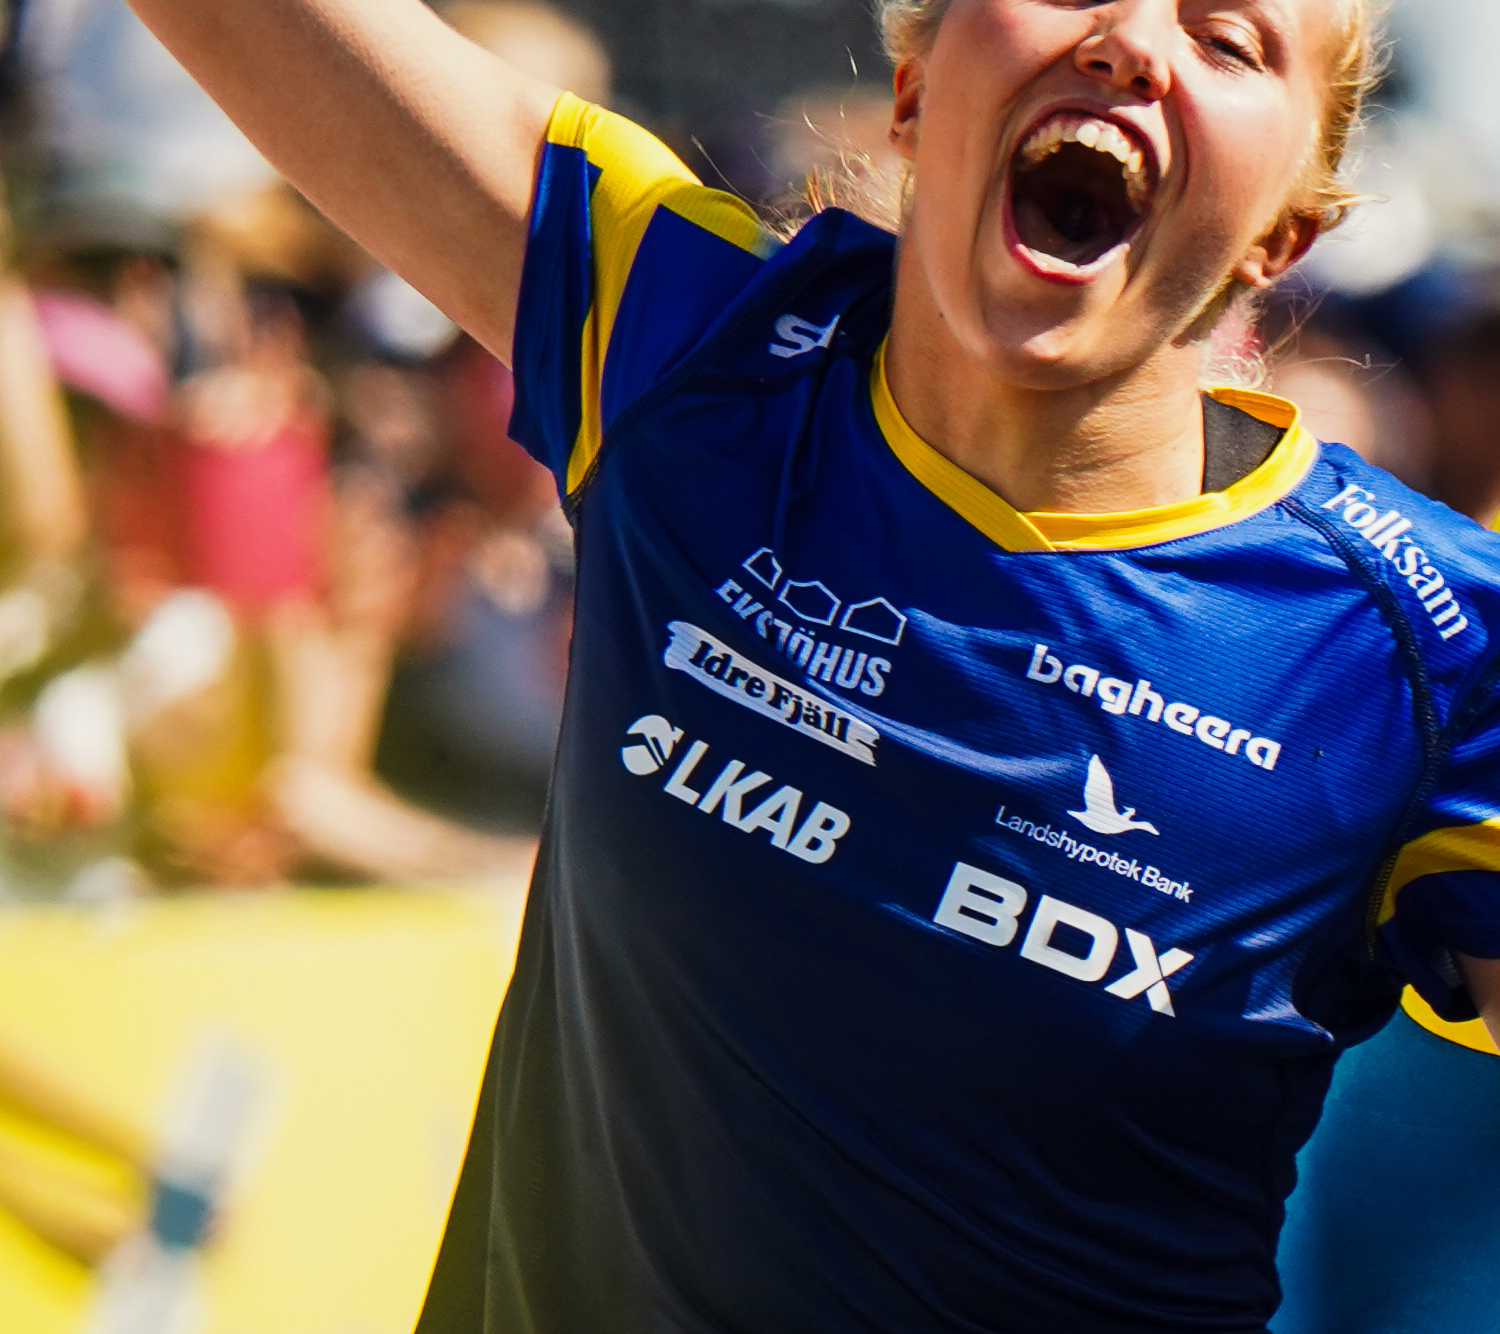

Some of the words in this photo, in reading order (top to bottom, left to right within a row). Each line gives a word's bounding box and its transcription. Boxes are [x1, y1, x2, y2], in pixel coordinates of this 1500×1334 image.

[1320, 483, 1469, 641] Folksam
[689, 640, 766, 699] Idre
[767, 686, 851, 744] Fjäll
[1026, 643, 1283, 771] bagheera
[663, 739, 851, 864] LKAB
[995, 805, 1144, 883] Landshypotek
[1140, 865, 1195, 904] Bank
[932, 860, 1195, 1018] BDX
